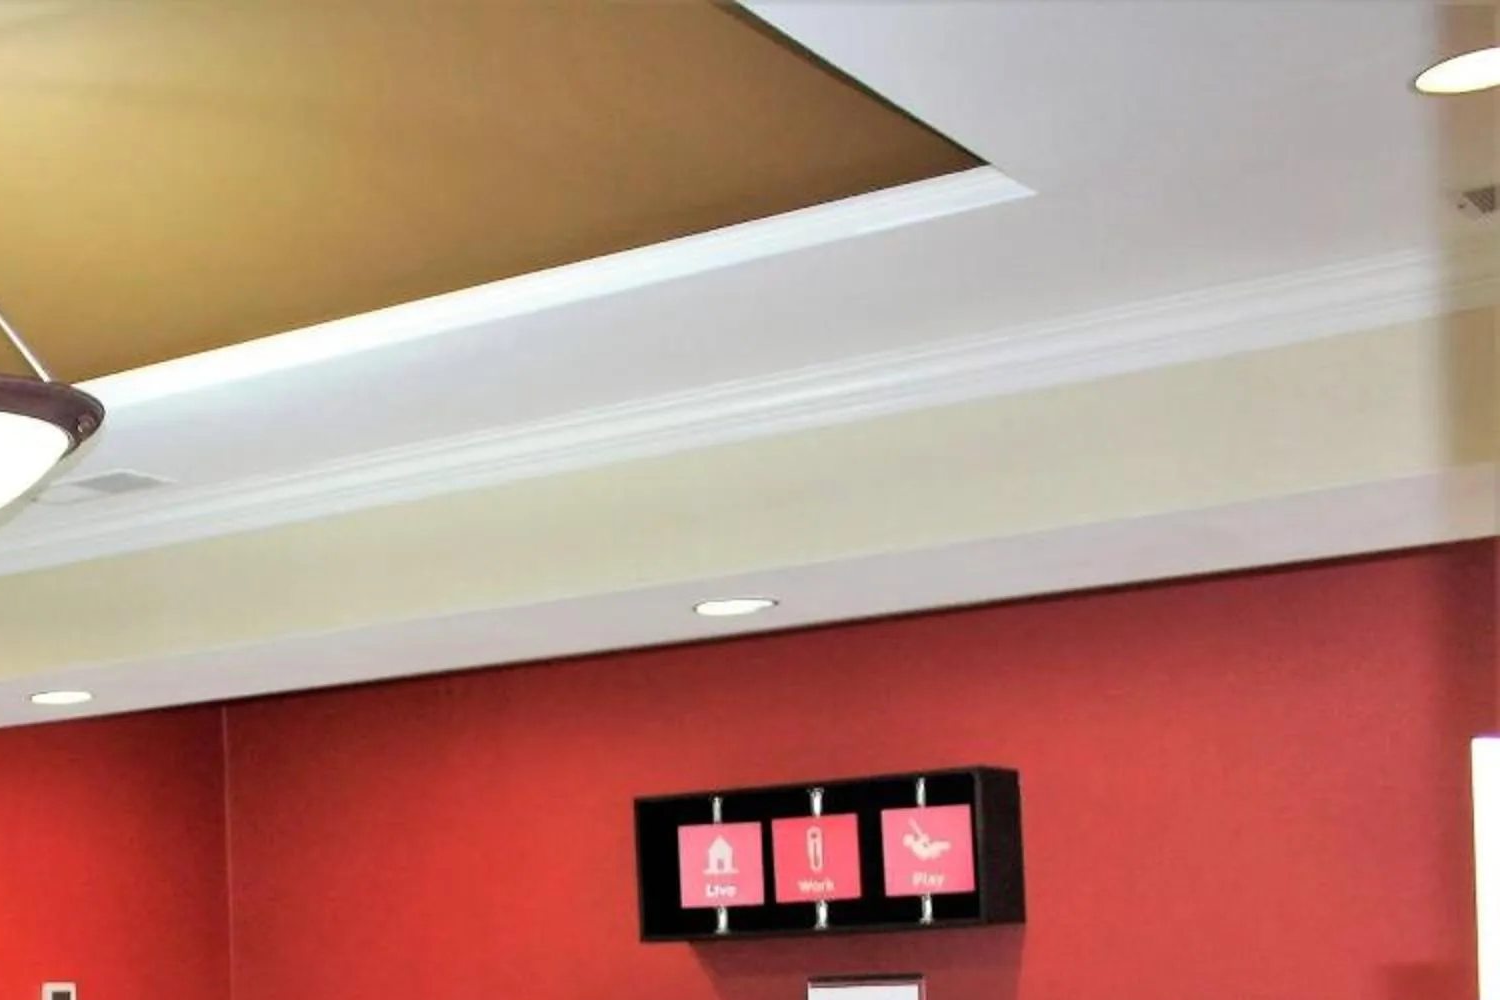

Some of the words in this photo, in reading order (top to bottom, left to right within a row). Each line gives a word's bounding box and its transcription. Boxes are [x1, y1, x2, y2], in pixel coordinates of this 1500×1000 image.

[797, 877, 835, 893] Work
[912, 871, 945, 888] Play
[705, 883, 737, 898] Live
